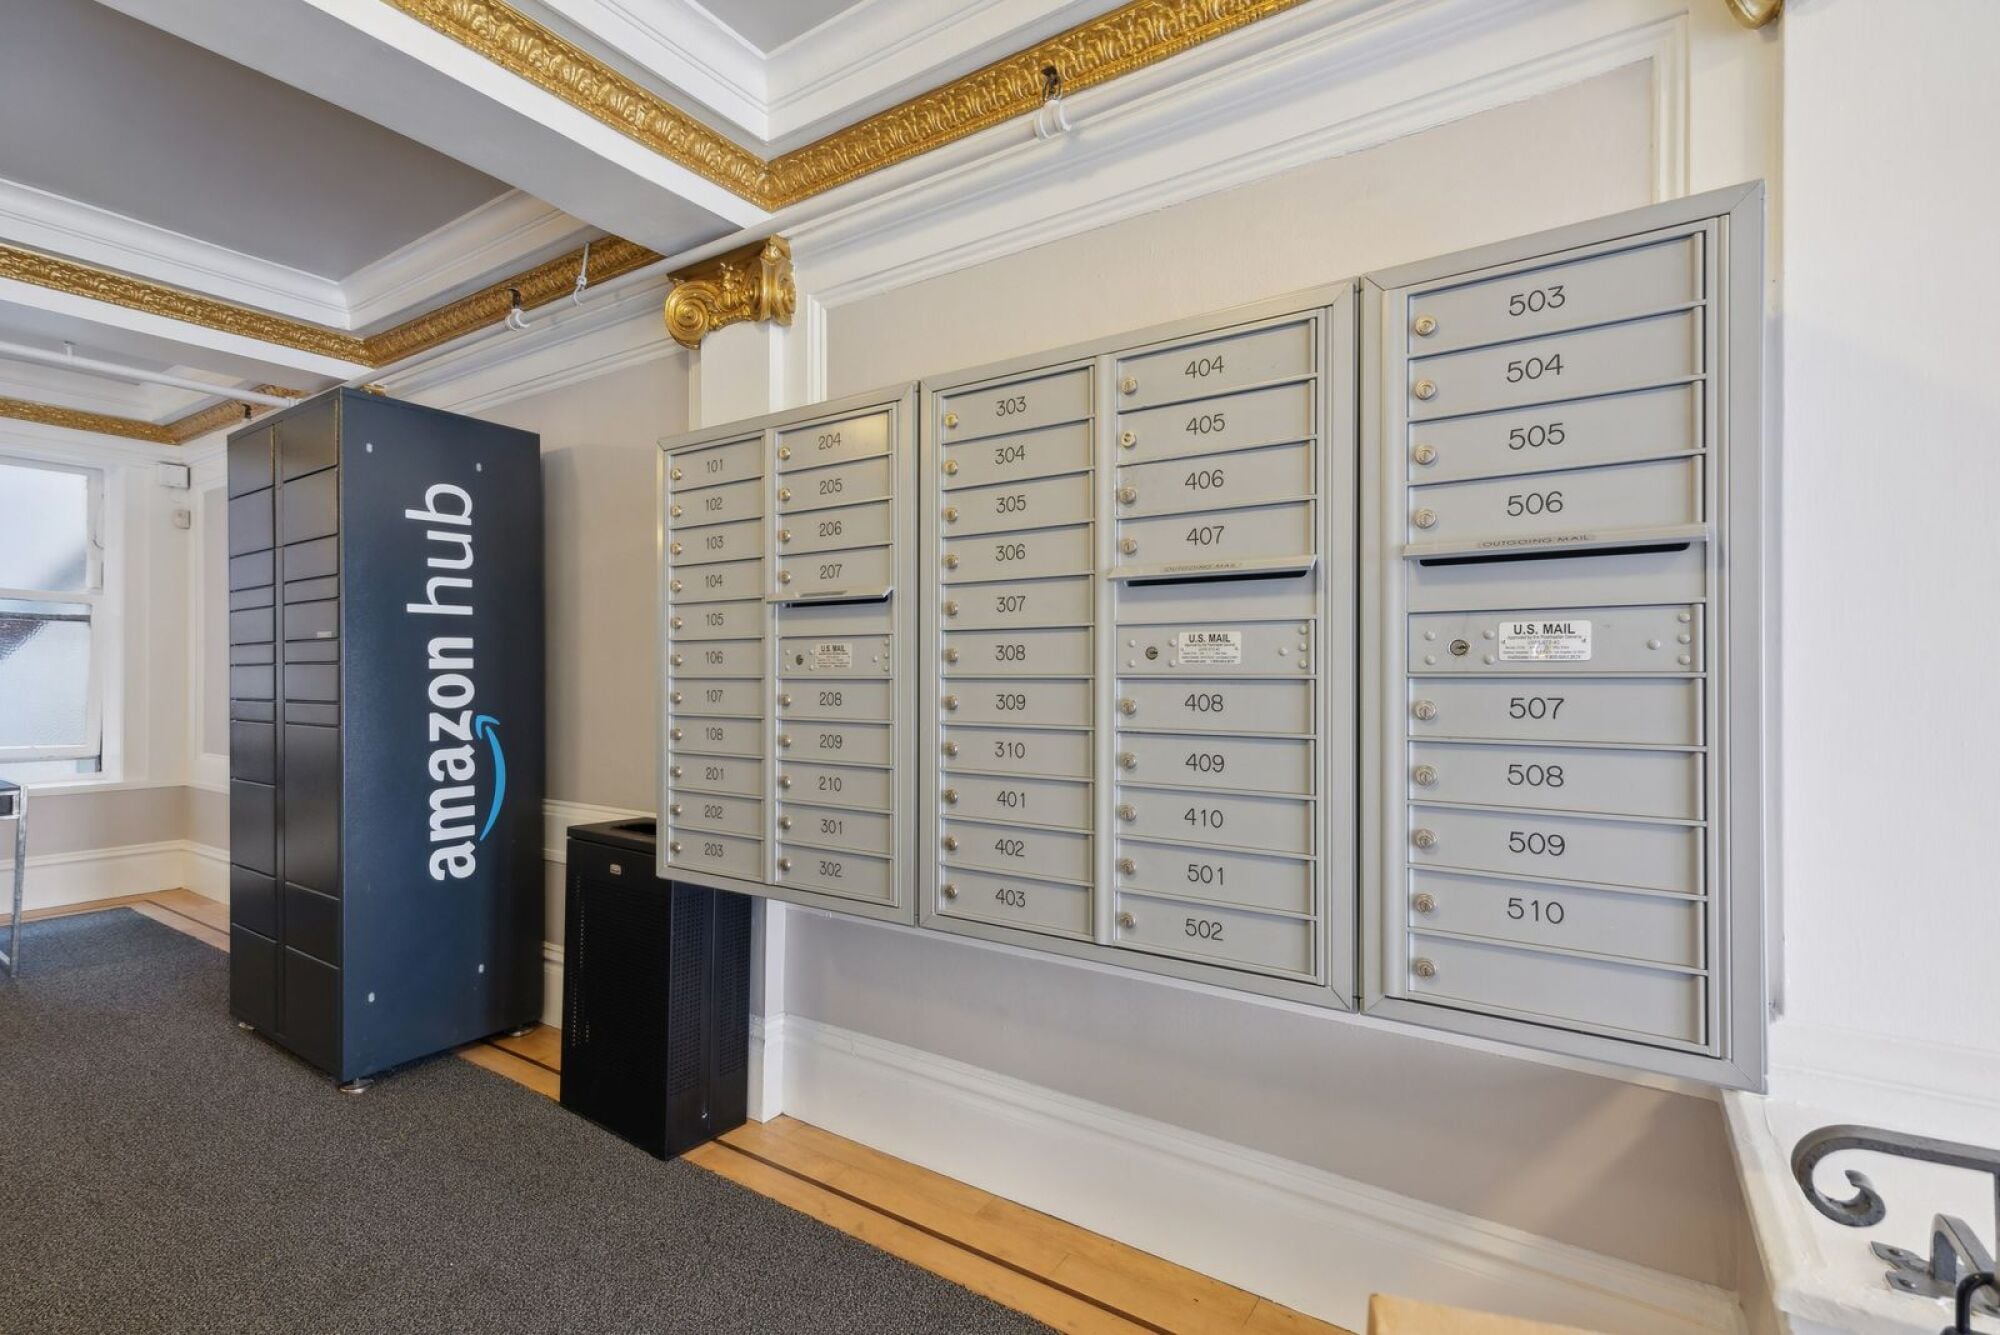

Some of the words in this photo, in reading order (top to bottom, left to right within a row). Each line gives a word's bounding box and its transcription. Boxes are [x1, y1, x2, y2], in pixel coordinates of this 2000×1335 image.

[1509, 285, 1565, 316] 503
[1185, 355, 1224, 379] 404
[1507, 354, 1564, 383] 504
[996, 396, 1026, 416] 303
[1186, 413, 1225, 435] 405
[819, 433, 841, 450] 204
[1509, 423, 1565, 450] 505
[995, 445, 1025, 465] 304
[707, 459, 723, 472] 101
[820, 478, 842, 495] 205
[1185, 469, 1224, 490] 406
[706, 497, 722, 510] 102
[996, 495, 1026, 513] 305
[1507, 491, 1563, 516] 506
[819, 521, 842, 537] 206
[1186, 526, 1224, 546] 407
[404, 482, 475, 616] hub
[706, 535, 723, 549] 103
[1481, 537, 1553, 547] OUTGOING
[1557, 534, 1590, 543] MAIL
[996, 544, 1025, 561] 306
[820, 563, 842, 579] 207
[705, 574, 723, 588] 104
[996, 596, 1026, 613] 307
[706, 613, 724, 626] 105
[1513, 624, 1538, 635] U.S.
[1543, 623, 1576, 635] MAIL
[1188, 633, 1205, 643] U.S.
[1208, 633, 1231, 642] MAIL
[706, 651, 723, 664] 106
[996, 644, 1025, 662] 308
[706, 690, 724, 704] 107
[819, 692, 842, 706] 208
[996, 694, 1025, 710] 309
[1185, 694, 1223, 712] 408
[1510, 697, 1564, 719] 507
[706, 727, 724, 741] 108
[820, 734, 843, 749] 209
[427, 636, 476, 881] amazon
[995, 741, 1025, 759] 310
[1185, 753, 1224, 773] 409
[706, 767, 724, 780] 201
[1507, 764, 1564, 787] 508
[819, 776, 842, 792] 210
[997, 791, 1025, 808] 401
[705, 804, 723, 819] 202
[1184, 808, 1223, 828] 410
[821, 819, 842, 835] 301
[705, 842, 723, 858] 203
[995, 839, 1024, 857] 402
[1509, 831, 1565, 856] 509
[820, 861, 842, 878] 302
[1187, 864, 1223, 885] 501
[995, 888, 1026, 908] 403
[1507, 897, 1564, 924] 510
[1185, 918, 1223, 941] 502
